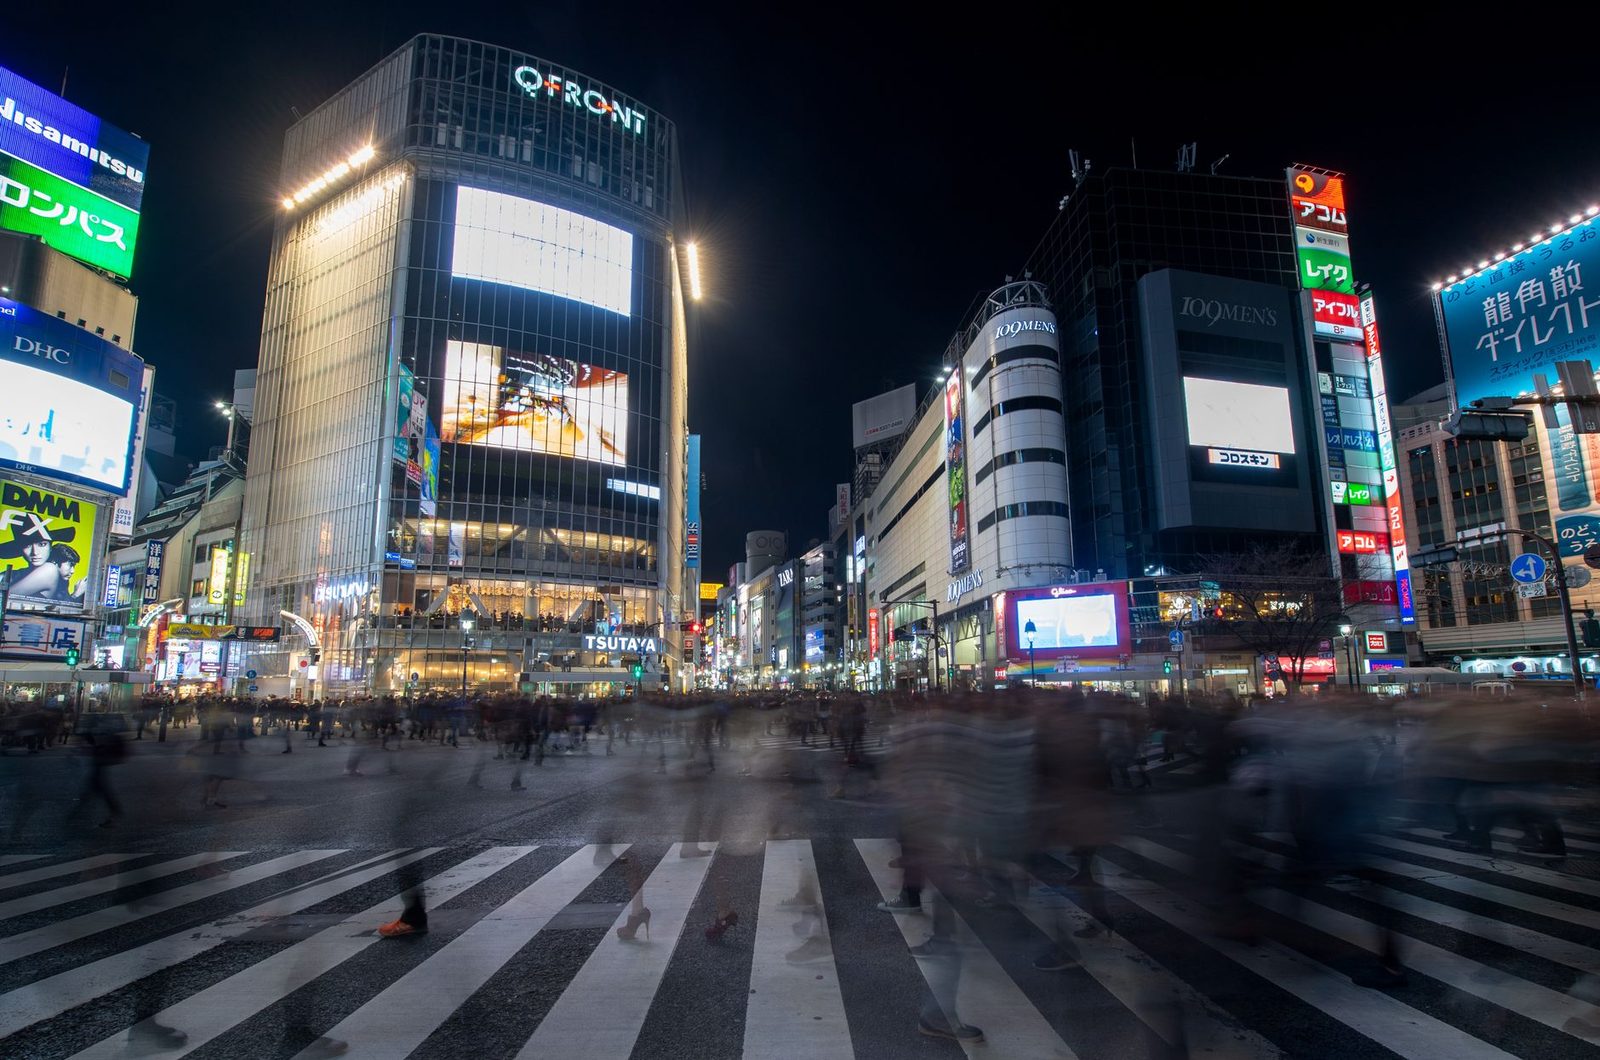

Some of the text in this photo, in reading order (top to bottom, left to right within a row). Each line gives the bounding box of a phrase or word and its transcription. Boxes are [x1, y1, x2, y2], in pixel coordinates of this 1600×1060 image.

[514, 65, 646, 134] QFRONT
[1299, 201, 1347, 225] アコム
[1306, 259, 1348, 282] レイク
[1482, 259, 1584, 329] 龍角散
[1314, 297, 1359, 319] アイフル
[1333, 325, 1345, 335] 8F
[1475, 295, 1600, 362] ダイレクト
[14, 335, 70, 365] DHC
[15, 463, 37, 473] DHC
[1218, 452, 1269, 466] コロスキン
[2, 482, 81, 524] DMM
[1348, 489, 1369, 500] レイク
[0, 509, 54, 541] FX
[1390, 507, 1401, 530] アコム
[1342, 535, 1376, 549] アコム
[145, 543, 162, 600] 洋服の青山
[1401, 578, 1411, 609] PROMISE
[585, 635, 656, 652] TSUTAYA
